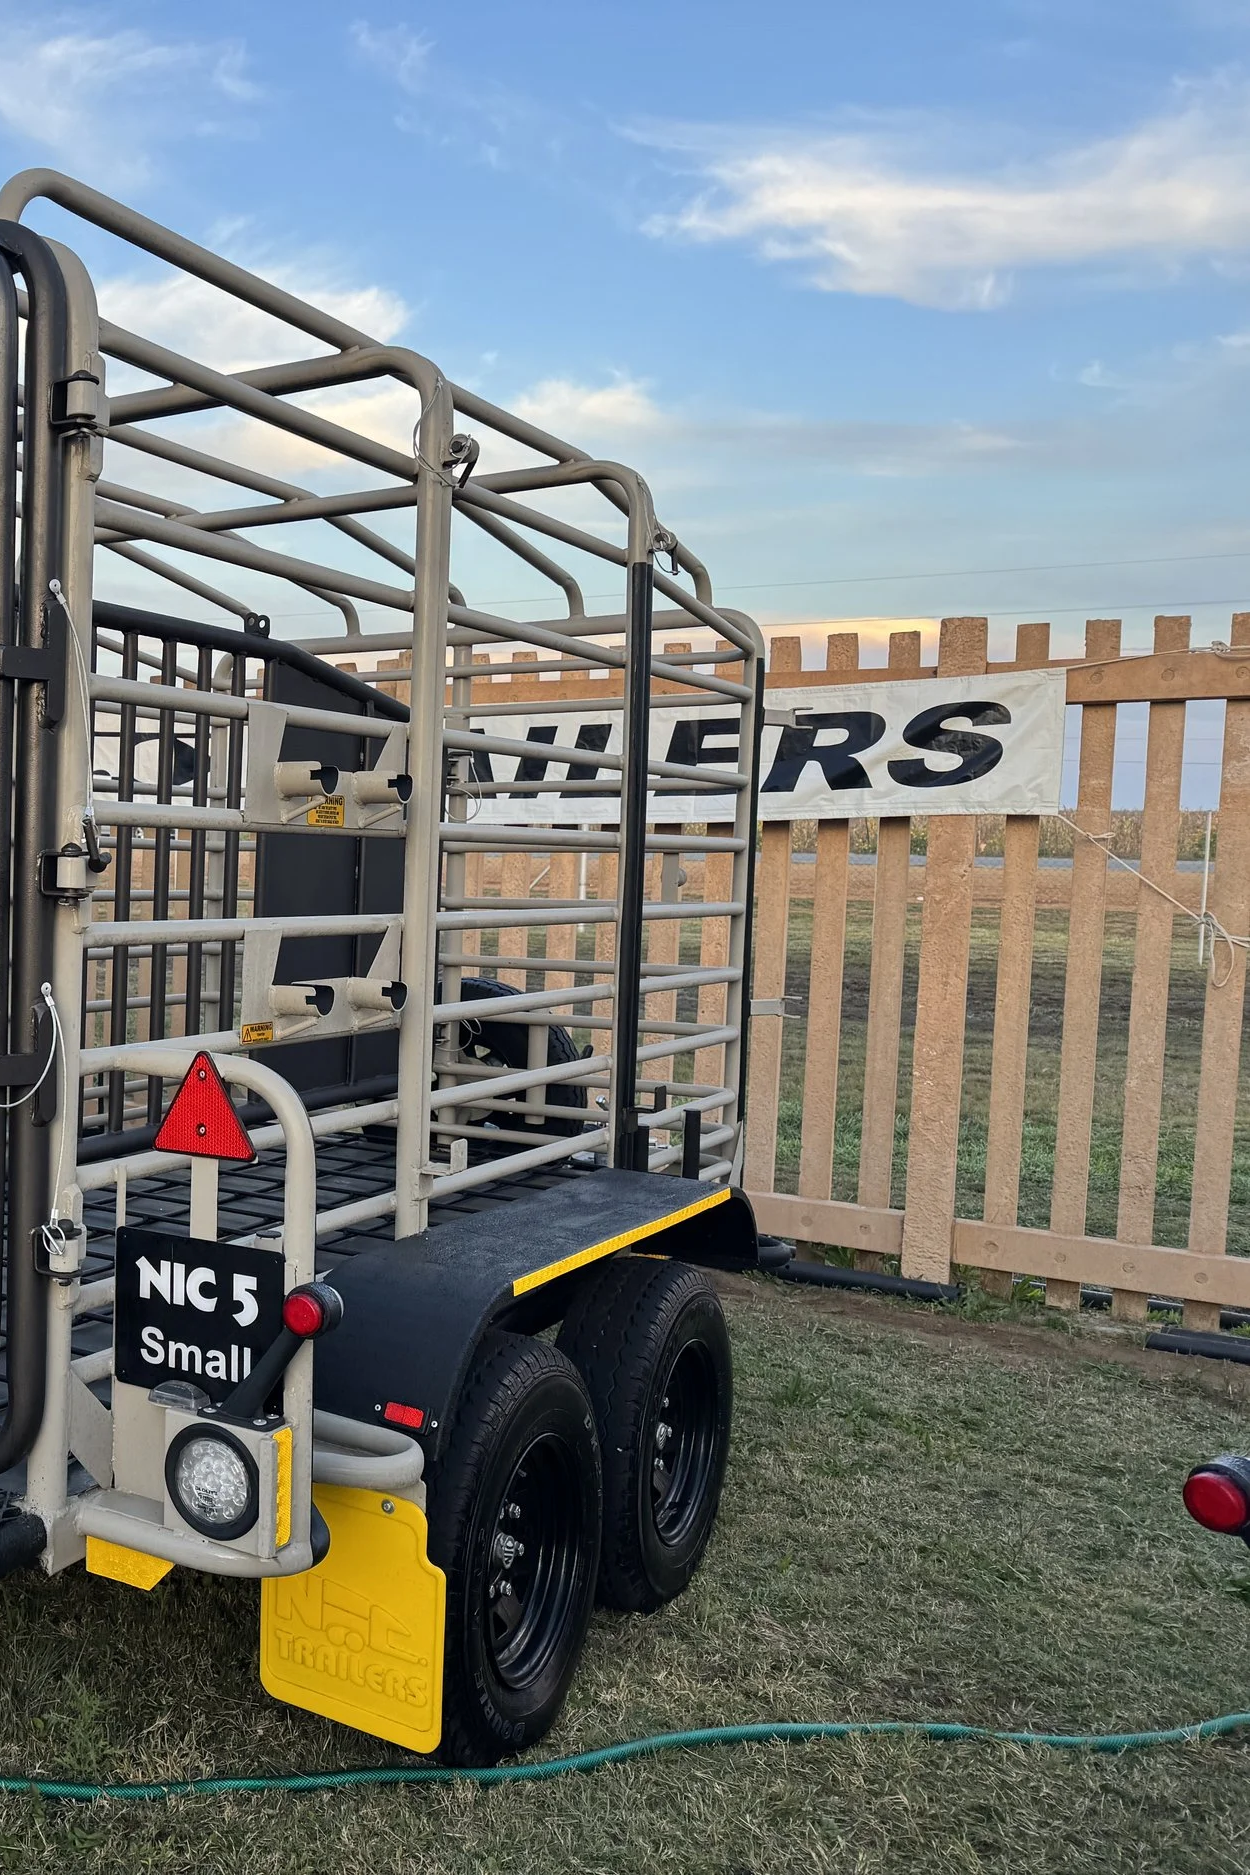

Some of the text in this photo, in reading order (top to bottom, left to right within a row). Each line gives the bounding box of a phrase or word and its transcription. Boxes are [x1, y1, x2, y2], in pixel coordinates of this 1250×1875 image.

[135, 1255, 259, 1328] NIC 5
[140, 1326, 252, 1383] Small
[274, 1627, 429, 1709] TRAILERS
